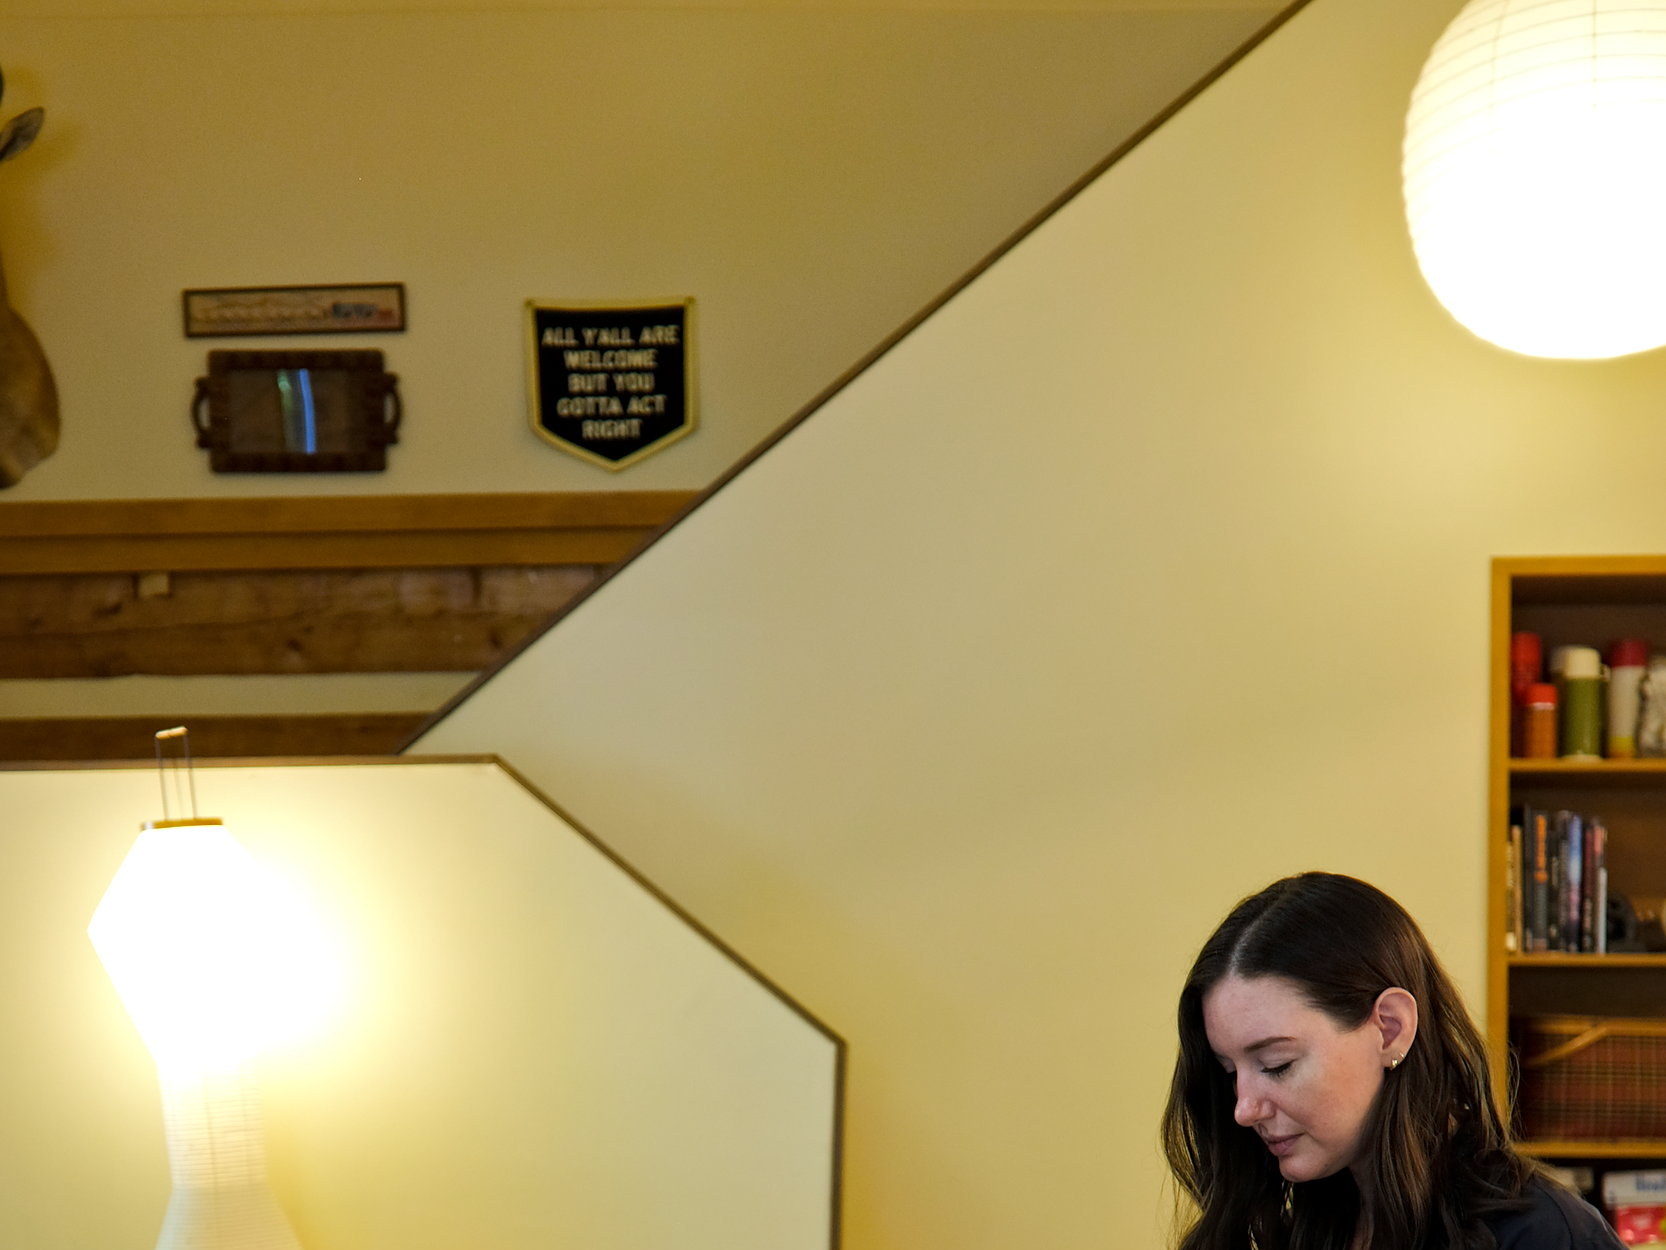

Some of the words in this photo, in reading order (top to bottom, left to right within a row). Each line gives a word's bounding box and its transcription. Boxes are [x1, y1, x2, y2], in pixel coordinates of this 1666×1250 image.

[541, 326, 579, 346] ALL
[639, 324, 680, 345] ARE
[563, 349, 658, 370] WELCOME
[567, 373, 609, 393] BUT
[612, 372, 655, 393] YOU
[556, 396, 623, 417] GOTTA
[627, 394, 667, 415] ACT
[582, 418, 643, 439] RIGHT
